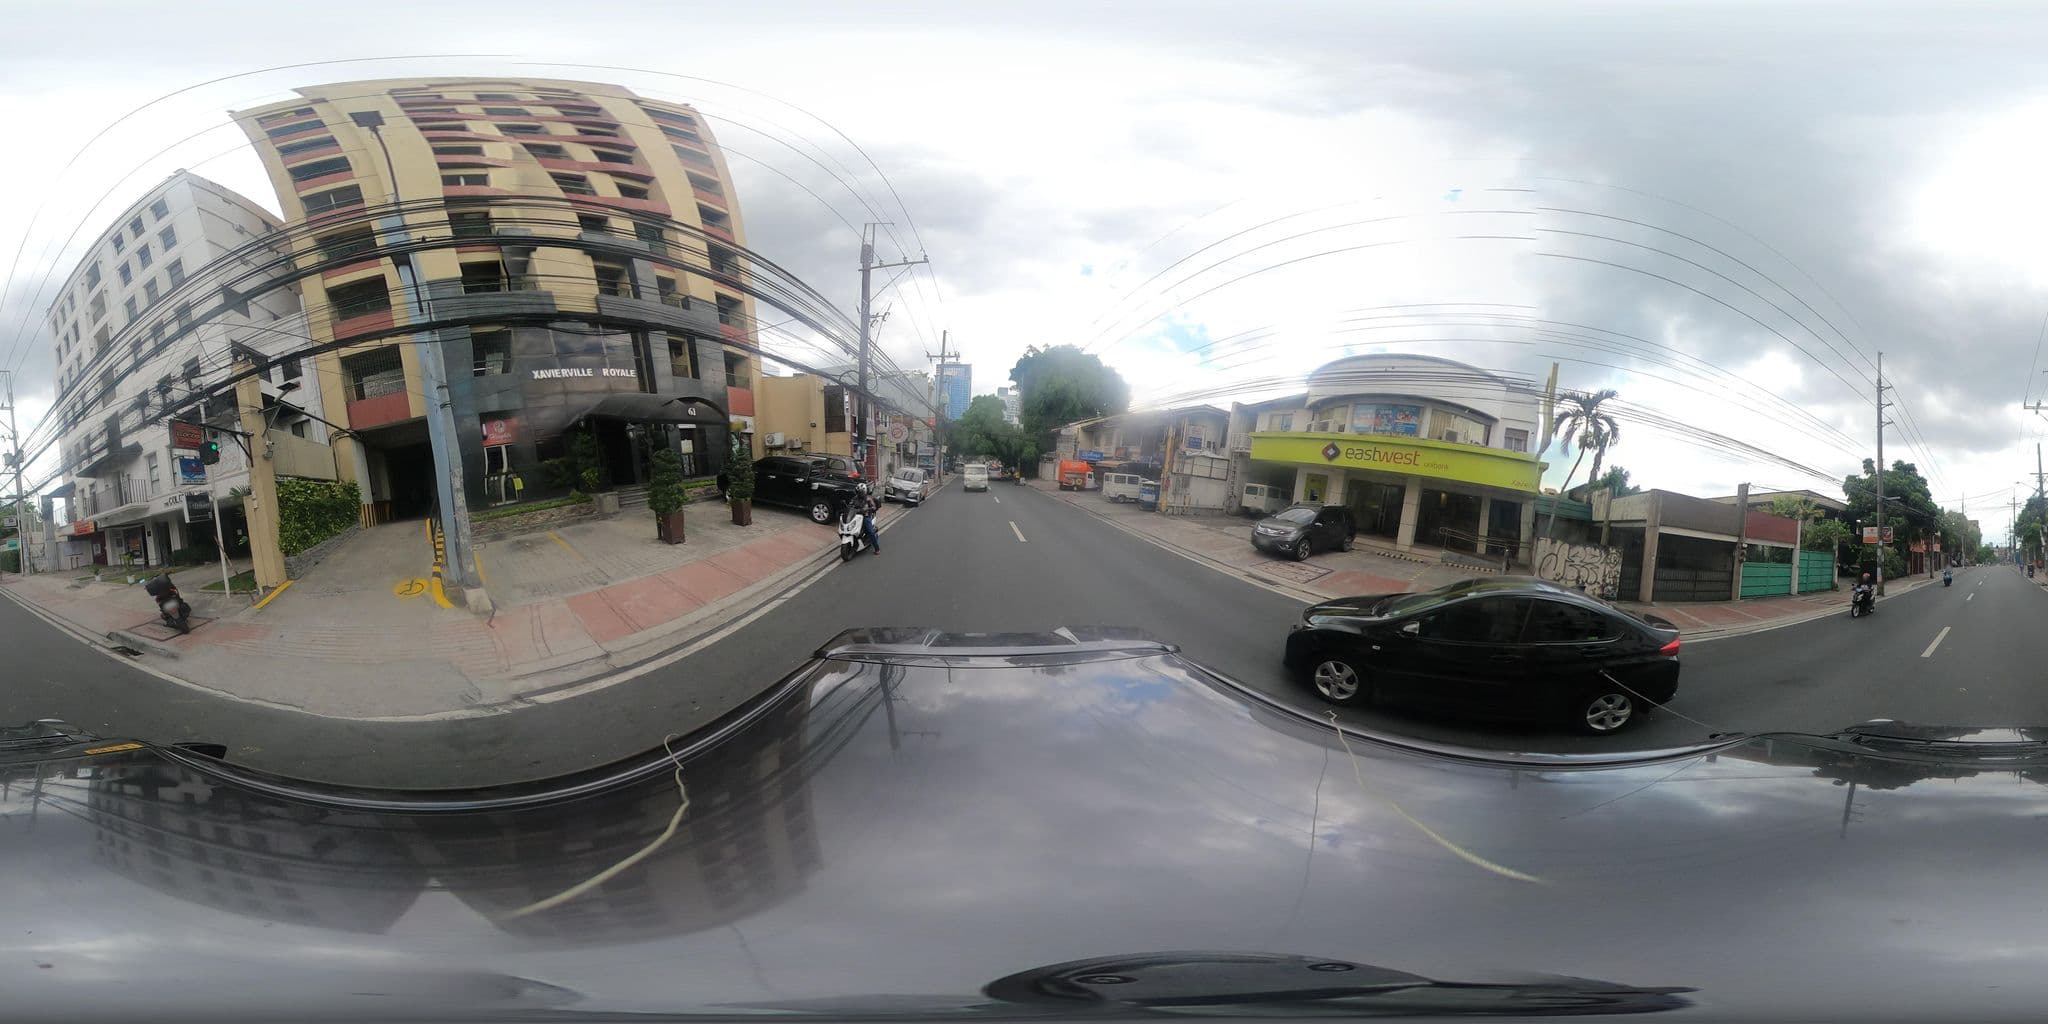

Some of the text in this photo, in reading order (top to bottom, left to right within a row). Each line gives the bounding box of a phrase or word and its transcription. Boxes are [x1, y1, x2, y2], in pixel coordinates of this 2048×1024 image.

[531, 368, 638, 379] XAVIERVILLE ROYALE
[687, 407, 697, 416] 61
[1345, 447, 1420, 466] eastwest
